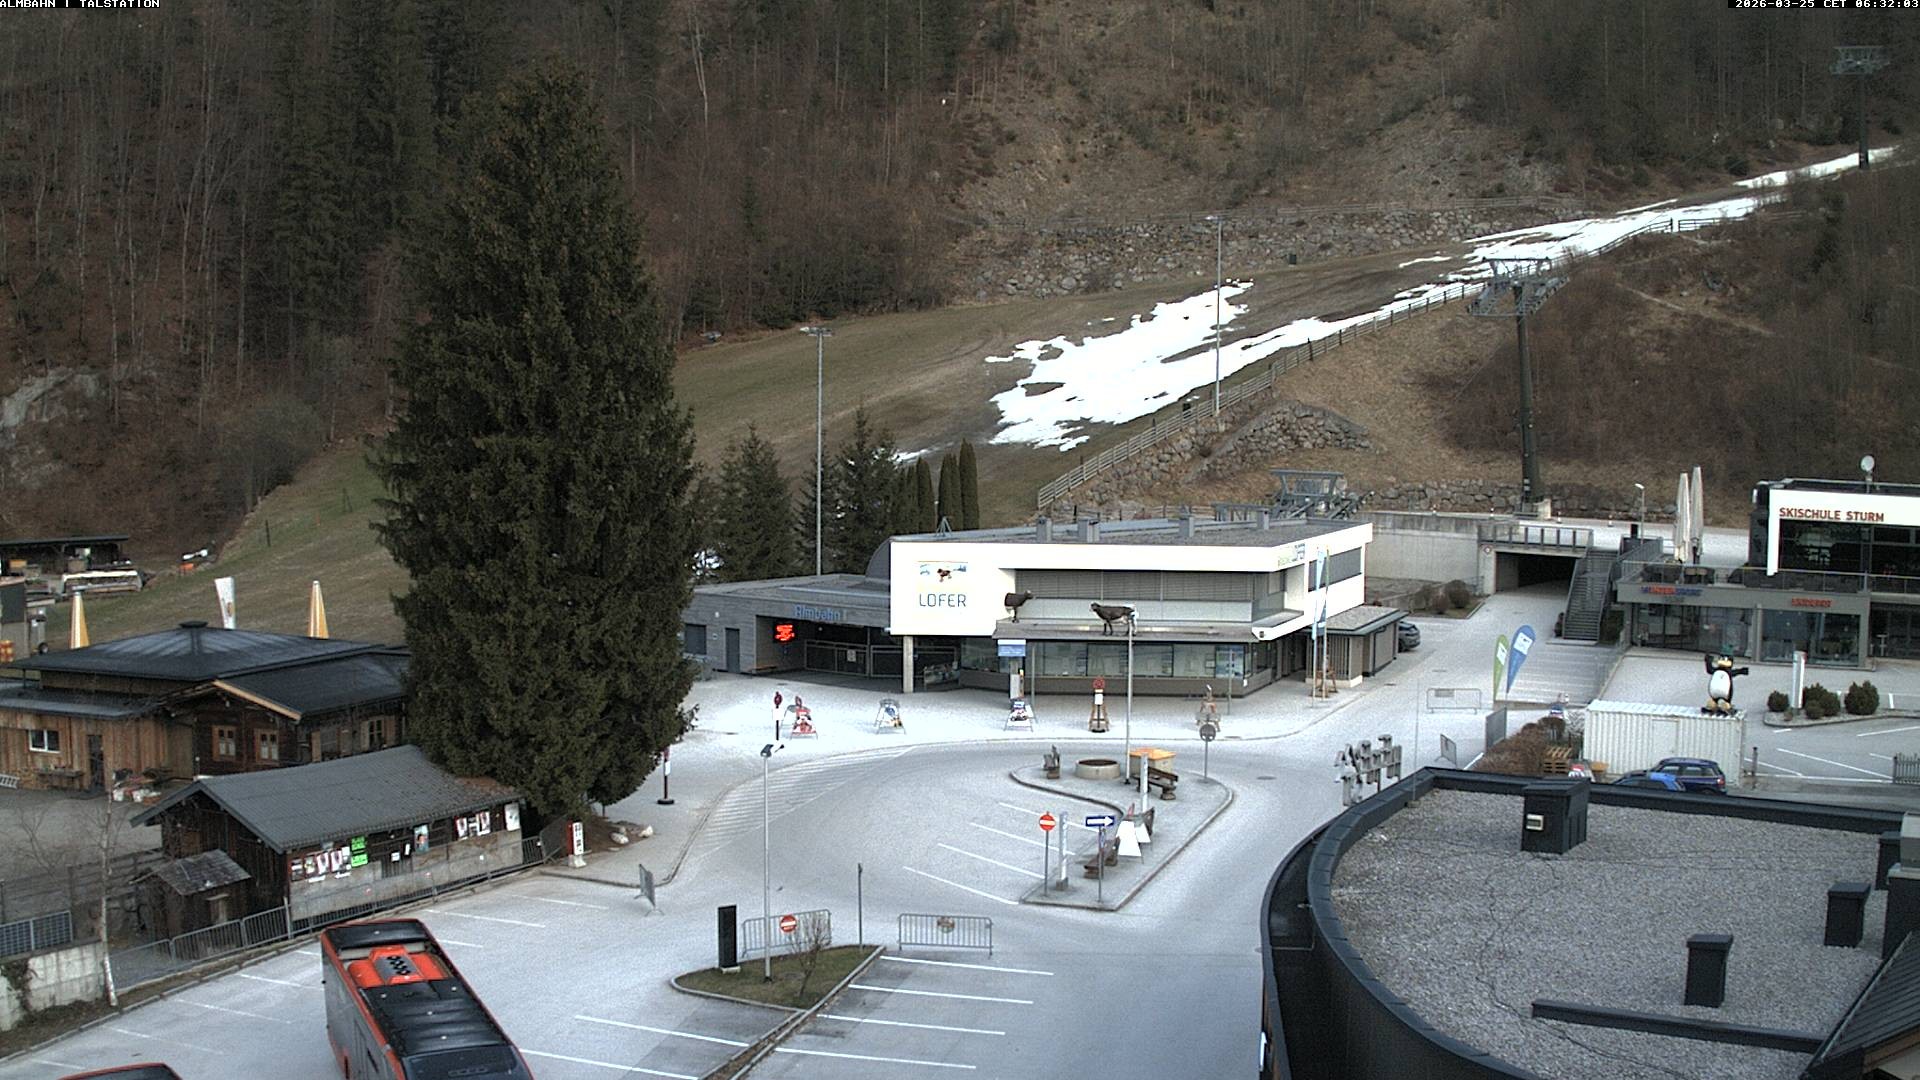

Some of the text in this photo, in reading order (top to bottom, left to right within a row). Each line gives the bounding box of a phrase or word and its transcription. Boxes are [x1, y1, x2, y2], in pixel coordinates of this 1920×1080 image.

[1779, 507, 1884, 522] SKISCHULE STURM
[919, 593, 967, 607] LOFER
